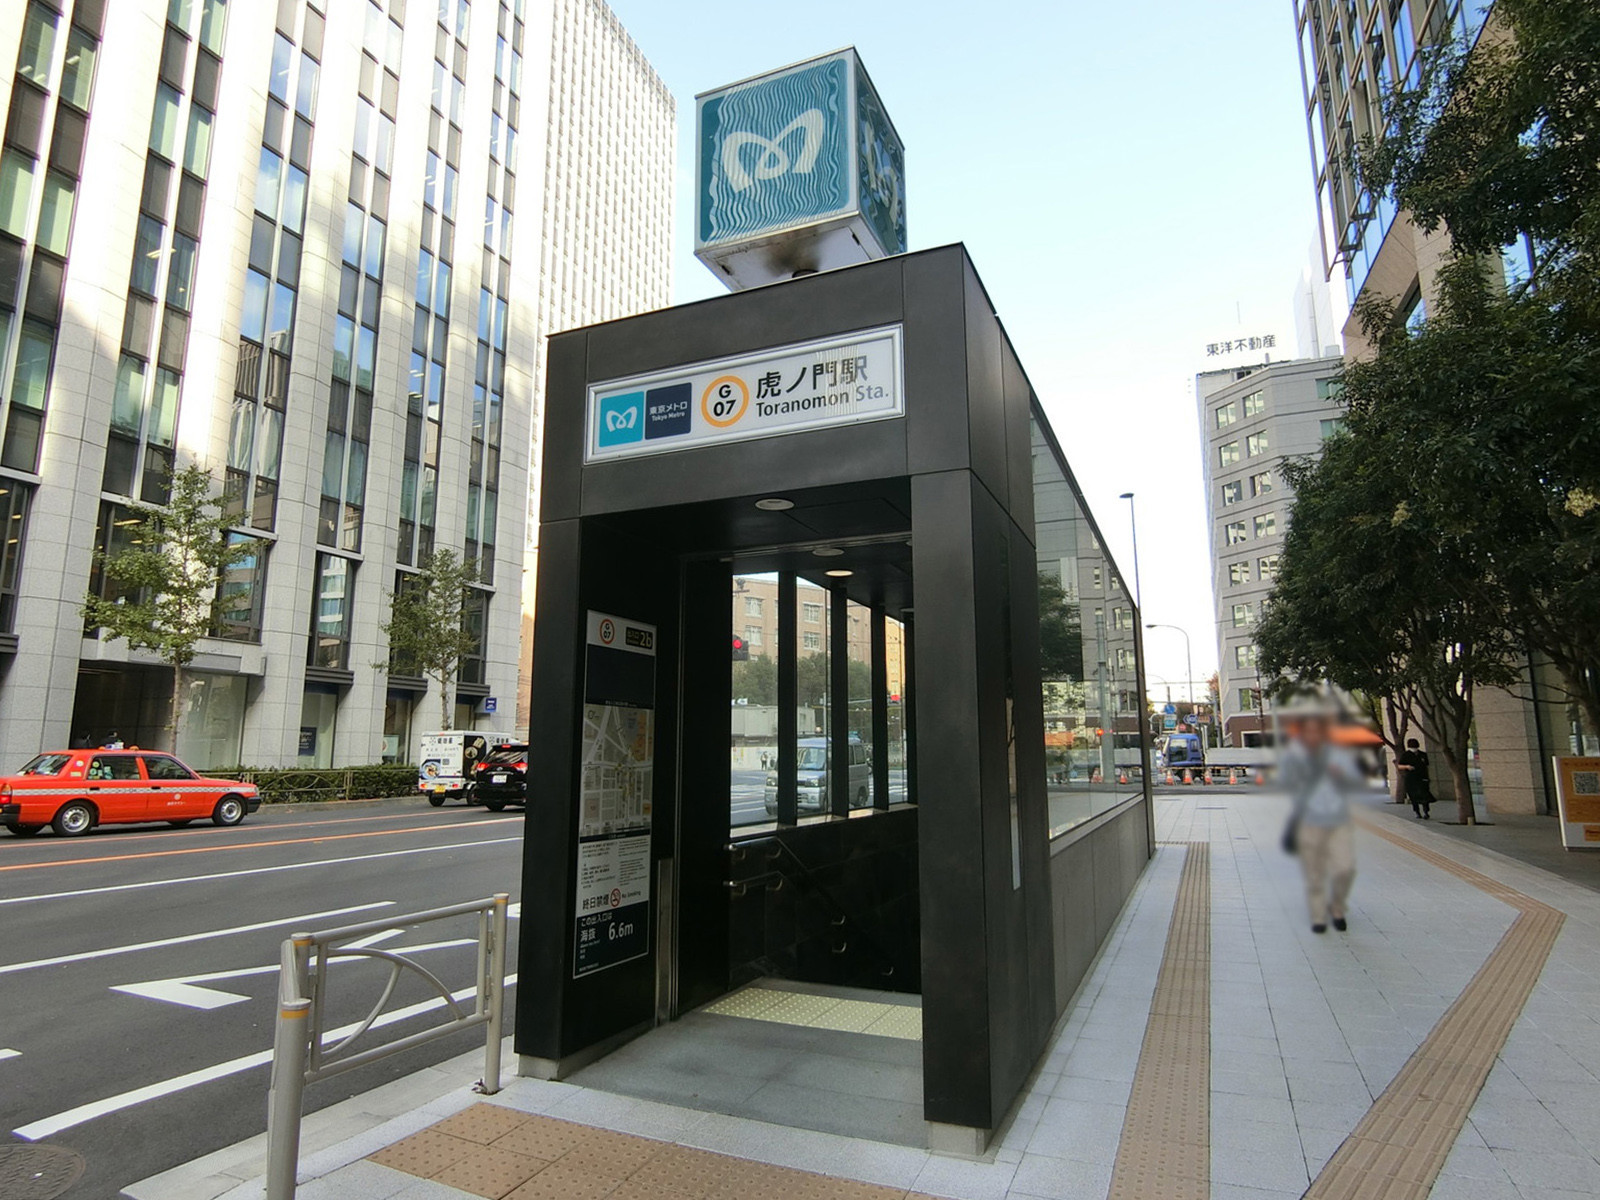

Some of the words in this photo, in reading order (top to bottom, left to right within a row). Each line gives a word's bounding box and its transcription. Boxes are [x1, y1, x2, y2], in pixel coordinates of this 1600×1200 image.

[1206, 334, 1276, 357] 東洋不動産
[756, 355, 868, 399] 虎ノ門駅
[718, 384, 731, 399] G
[649, 401, 688, 415] 東京メトロ
[713, 399, 736, 417] 07
[756, 391, 849, 417] Toranomon
[856, 385, 889, 401] Sta.
[652, 413, 668, 421] Tokyo
[668, 411, 685, 419] Metro
[640, 632, 652, 648] 2b
[608, 922, 634, 940] 6.6m
